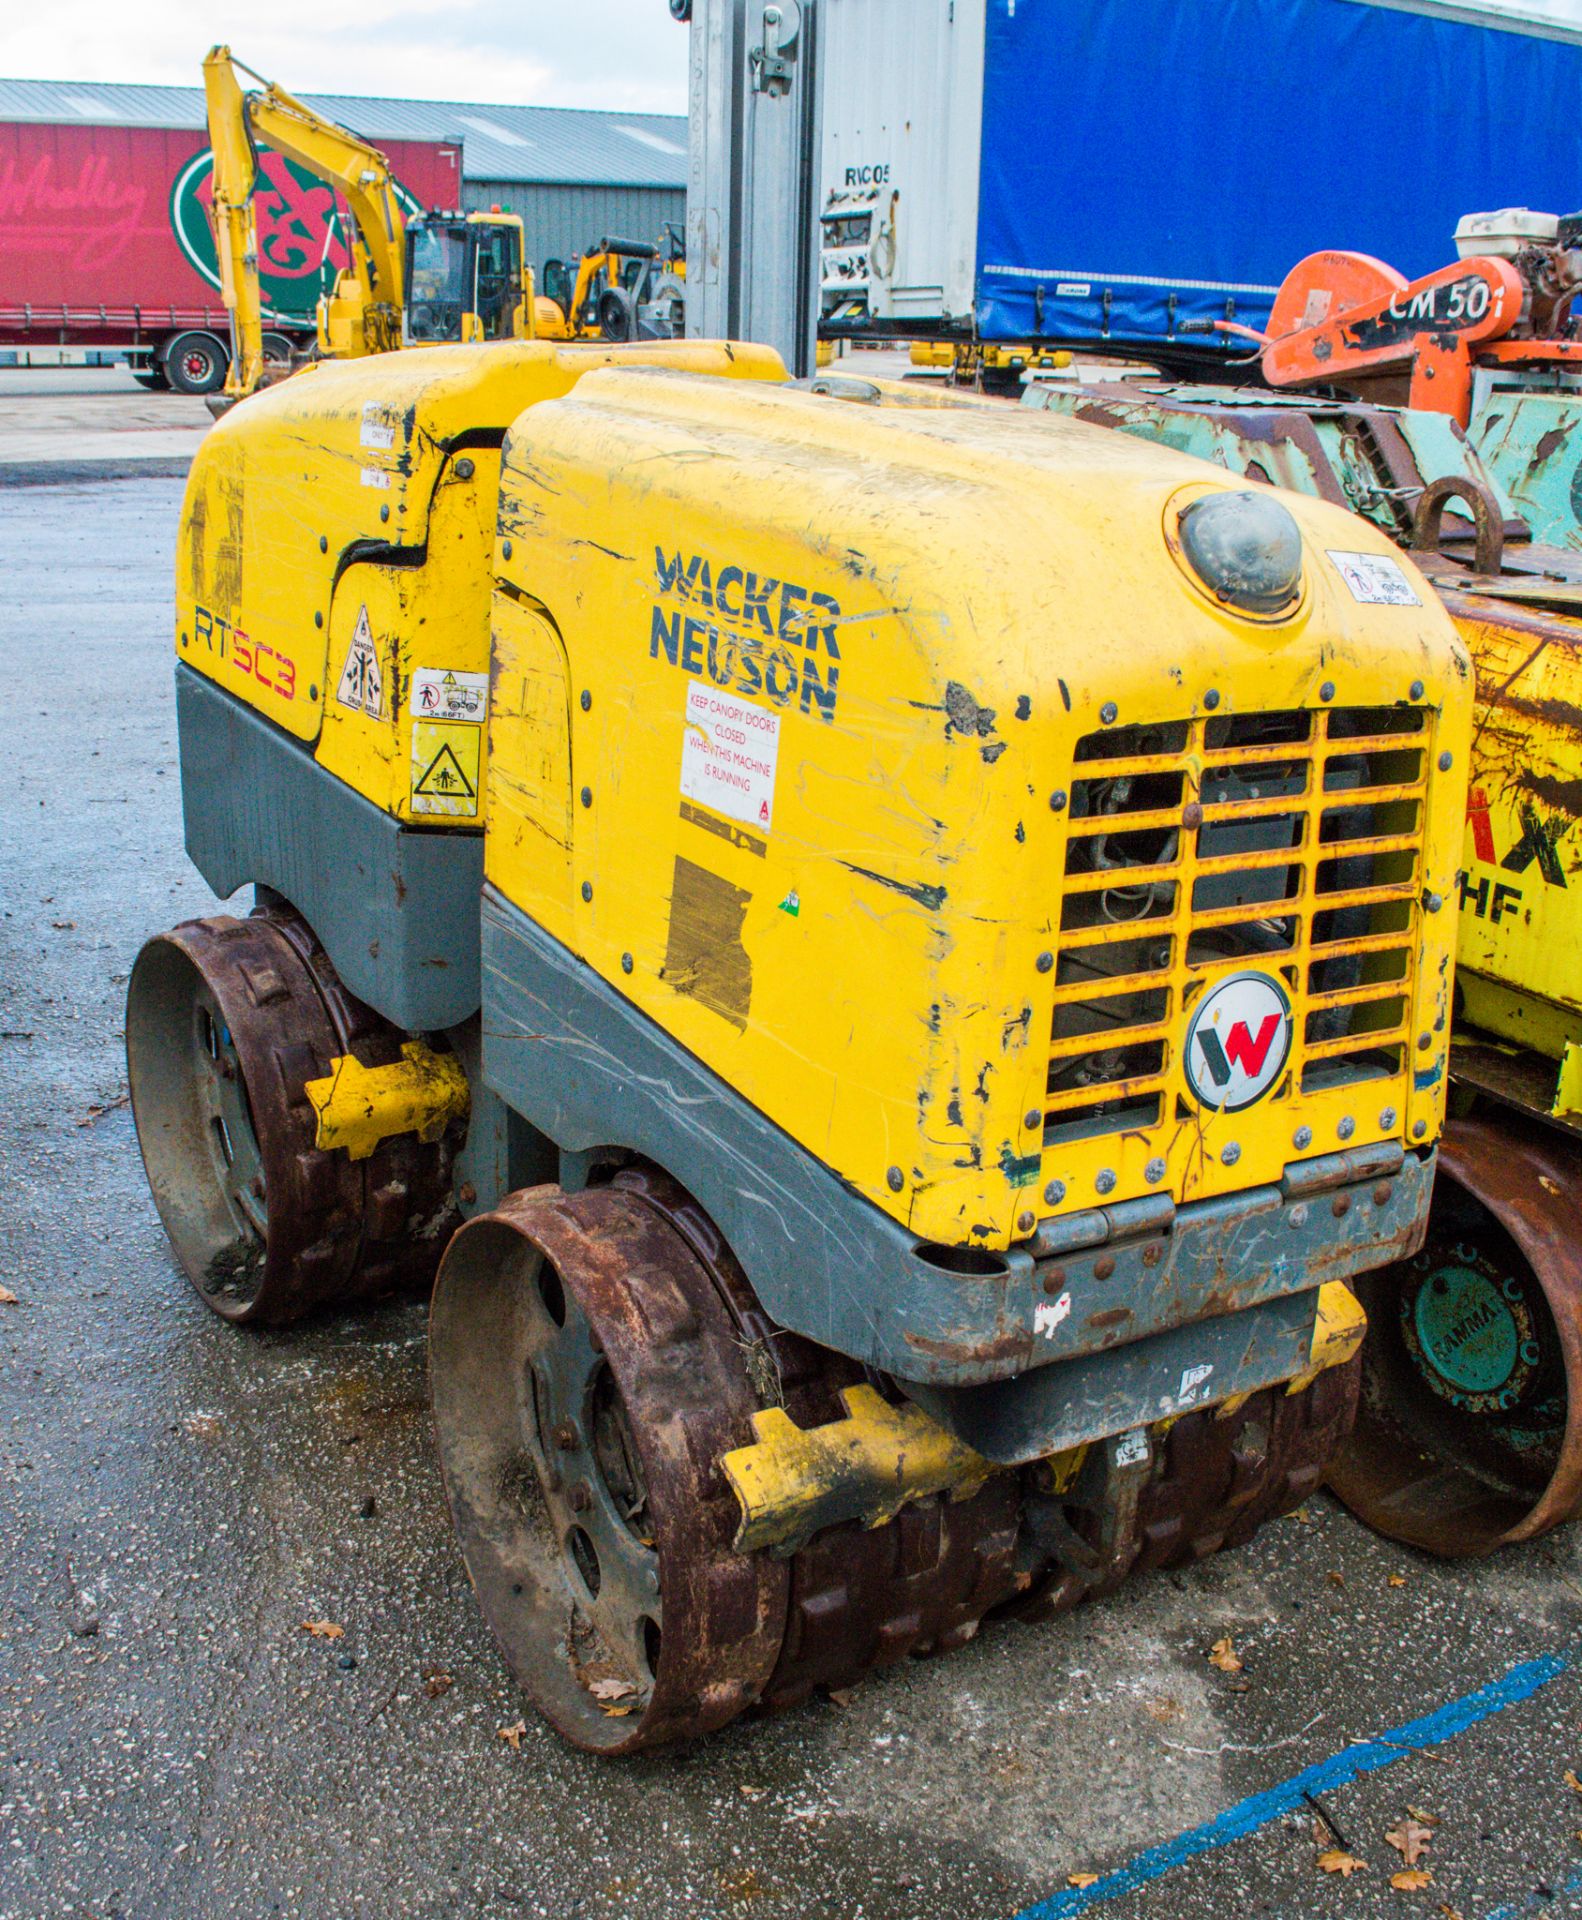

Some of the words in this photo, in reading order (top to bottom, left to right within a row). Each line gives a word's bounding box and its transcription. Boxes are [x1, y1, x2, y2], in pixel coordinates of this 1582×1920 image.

[1390, 285, 1435, 319] CM
[1447, 282, 1506, 318] 501
[655, 545, 842, 660] WACKER
[650, 604, 840, 723] NEUSON
[691, 693, 709, 709] KEEP
[710, 700, 744, 721] CANOPY
[745, 712, 776, 734] DOORS
[715, 723, 746, 745] CLOSED
[689, 735, 715, 756] WHEN
[715, 744, 732, 762] THIS
[733, 752, 771, 778] MACHINE
[704, 763, 711, 776] IS
[712, 766, 751, 792] RUNNING
